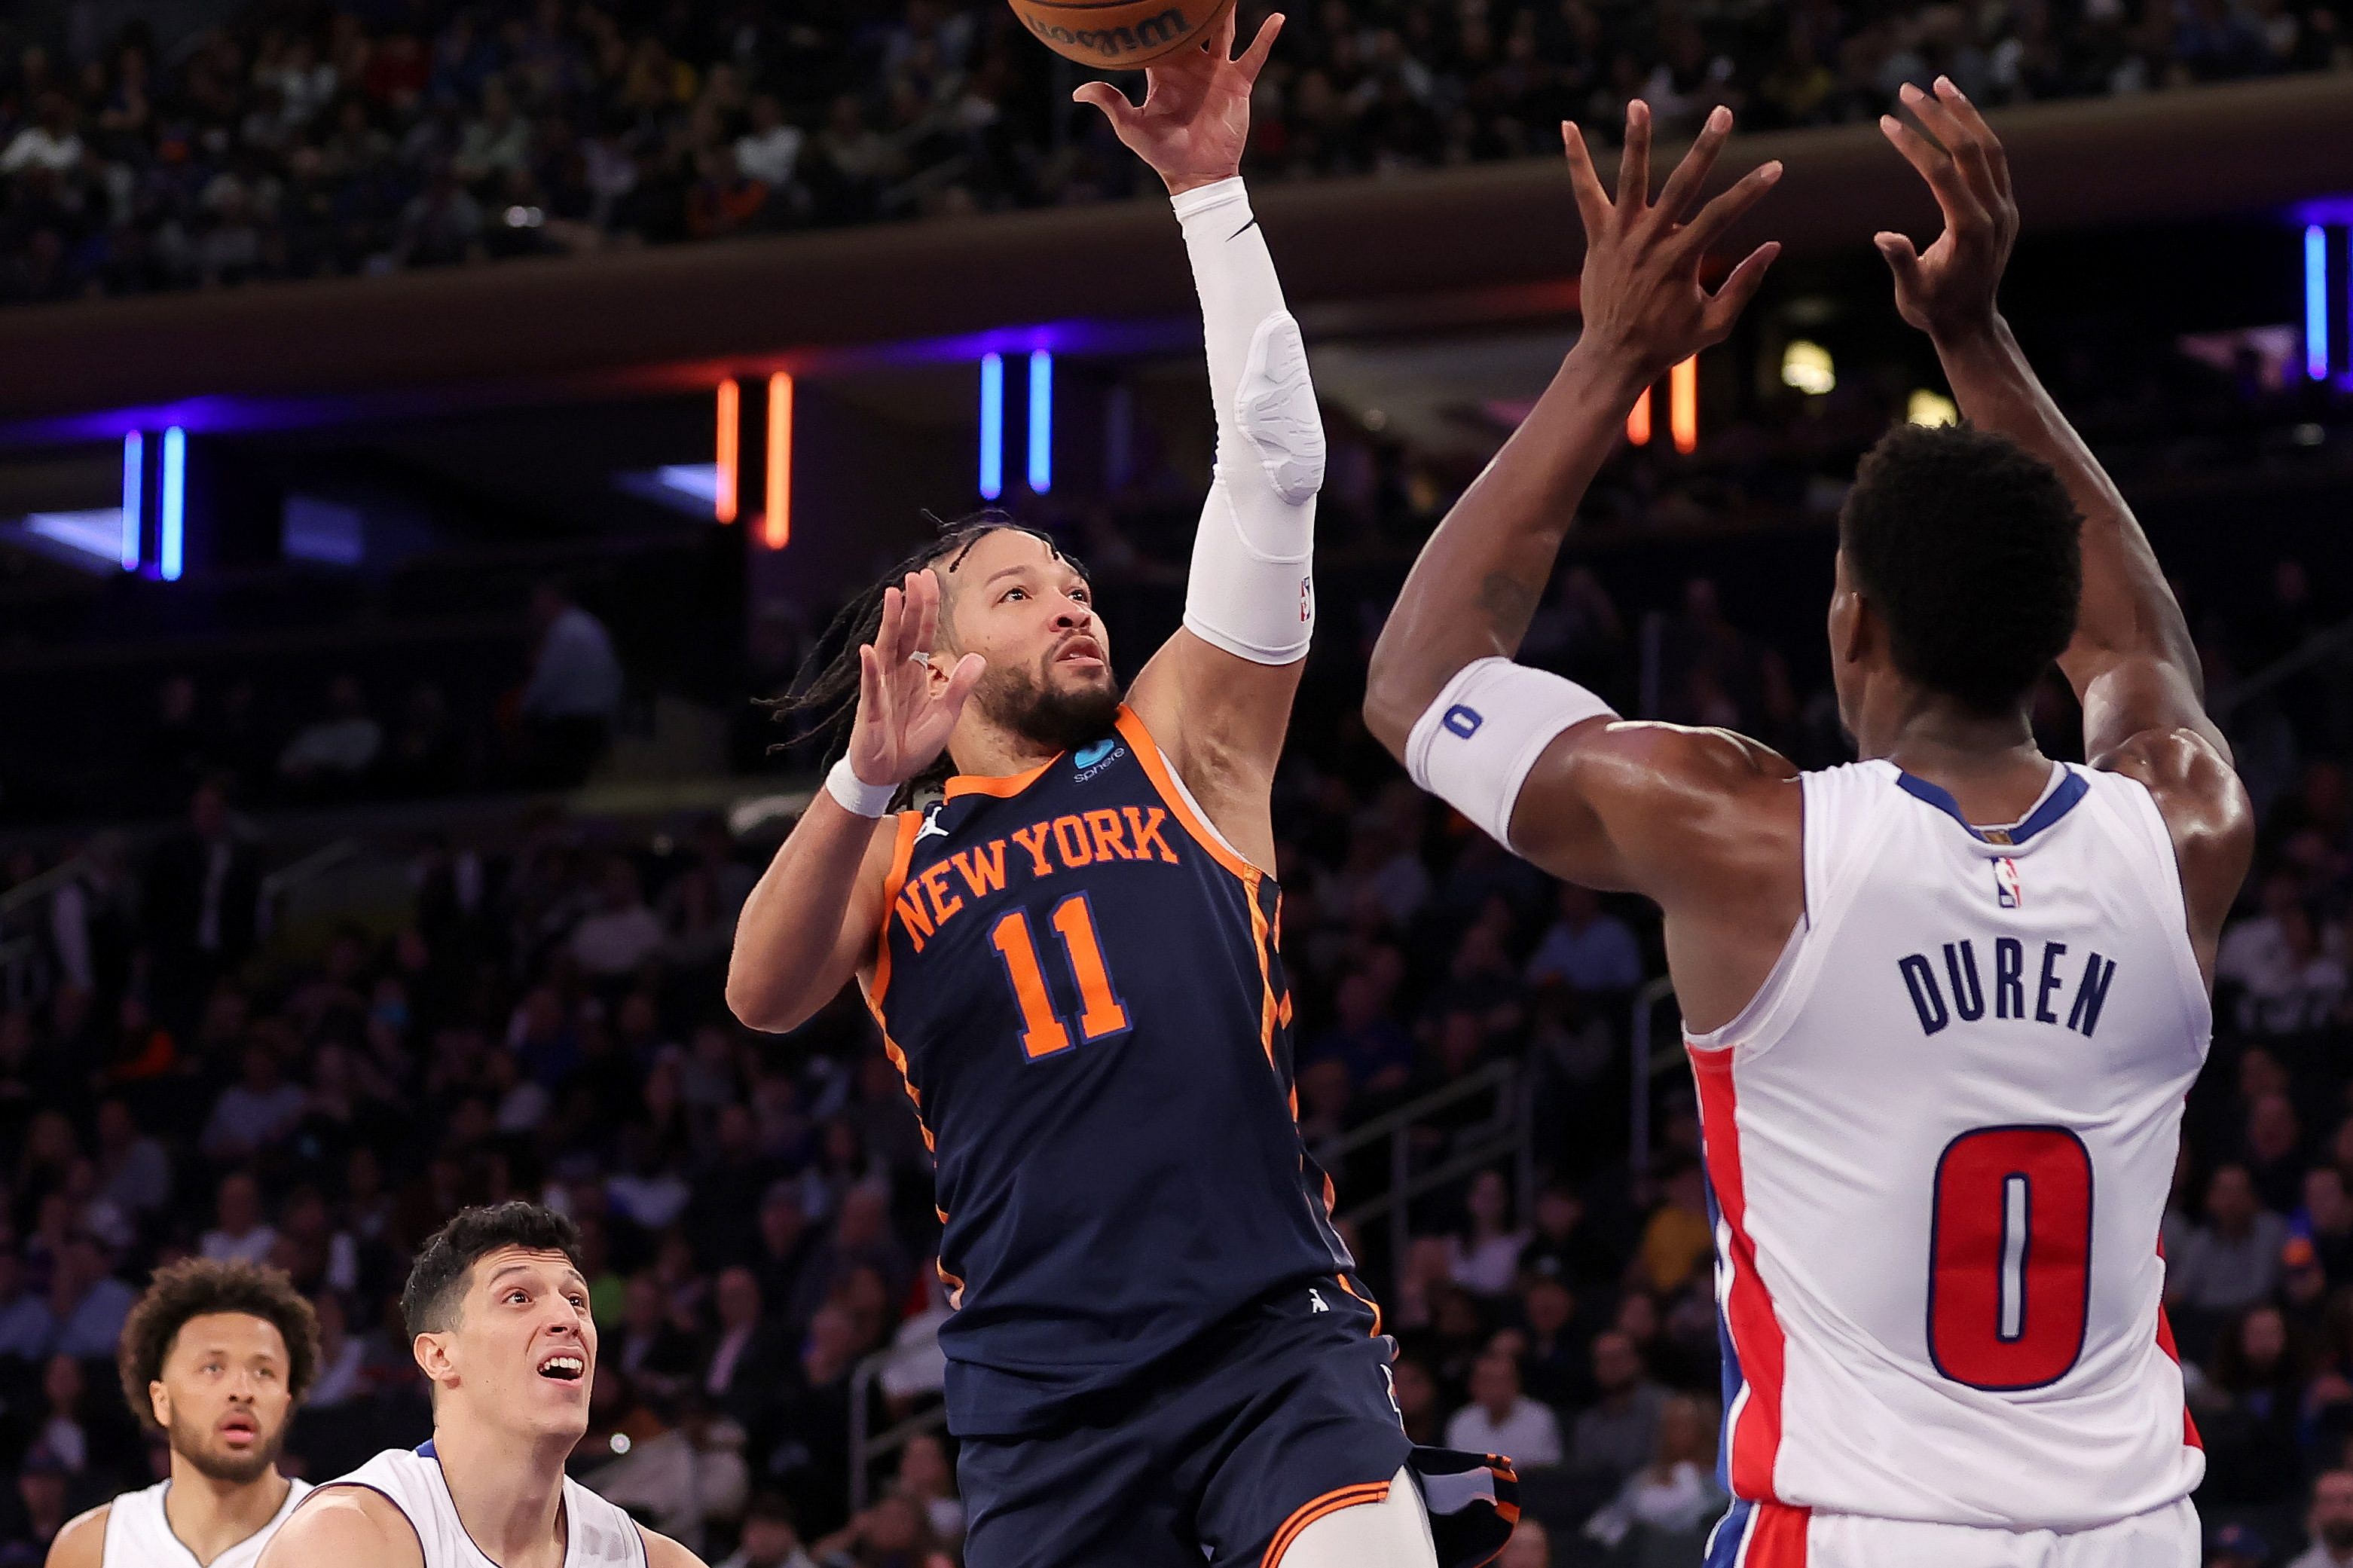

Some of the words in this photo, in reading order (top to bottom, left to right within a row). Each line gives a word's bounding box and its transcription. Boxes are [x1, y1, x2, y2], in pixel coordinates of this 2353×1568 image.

[894, 839, 1007, 953] NEW
[1011, 806, 1180, 878] YORK
[986, 890, 1133, 1064] 11
[1897, 937, 2117, 1038] DUREN
[1927, 1124, 2094, 1392] 0
